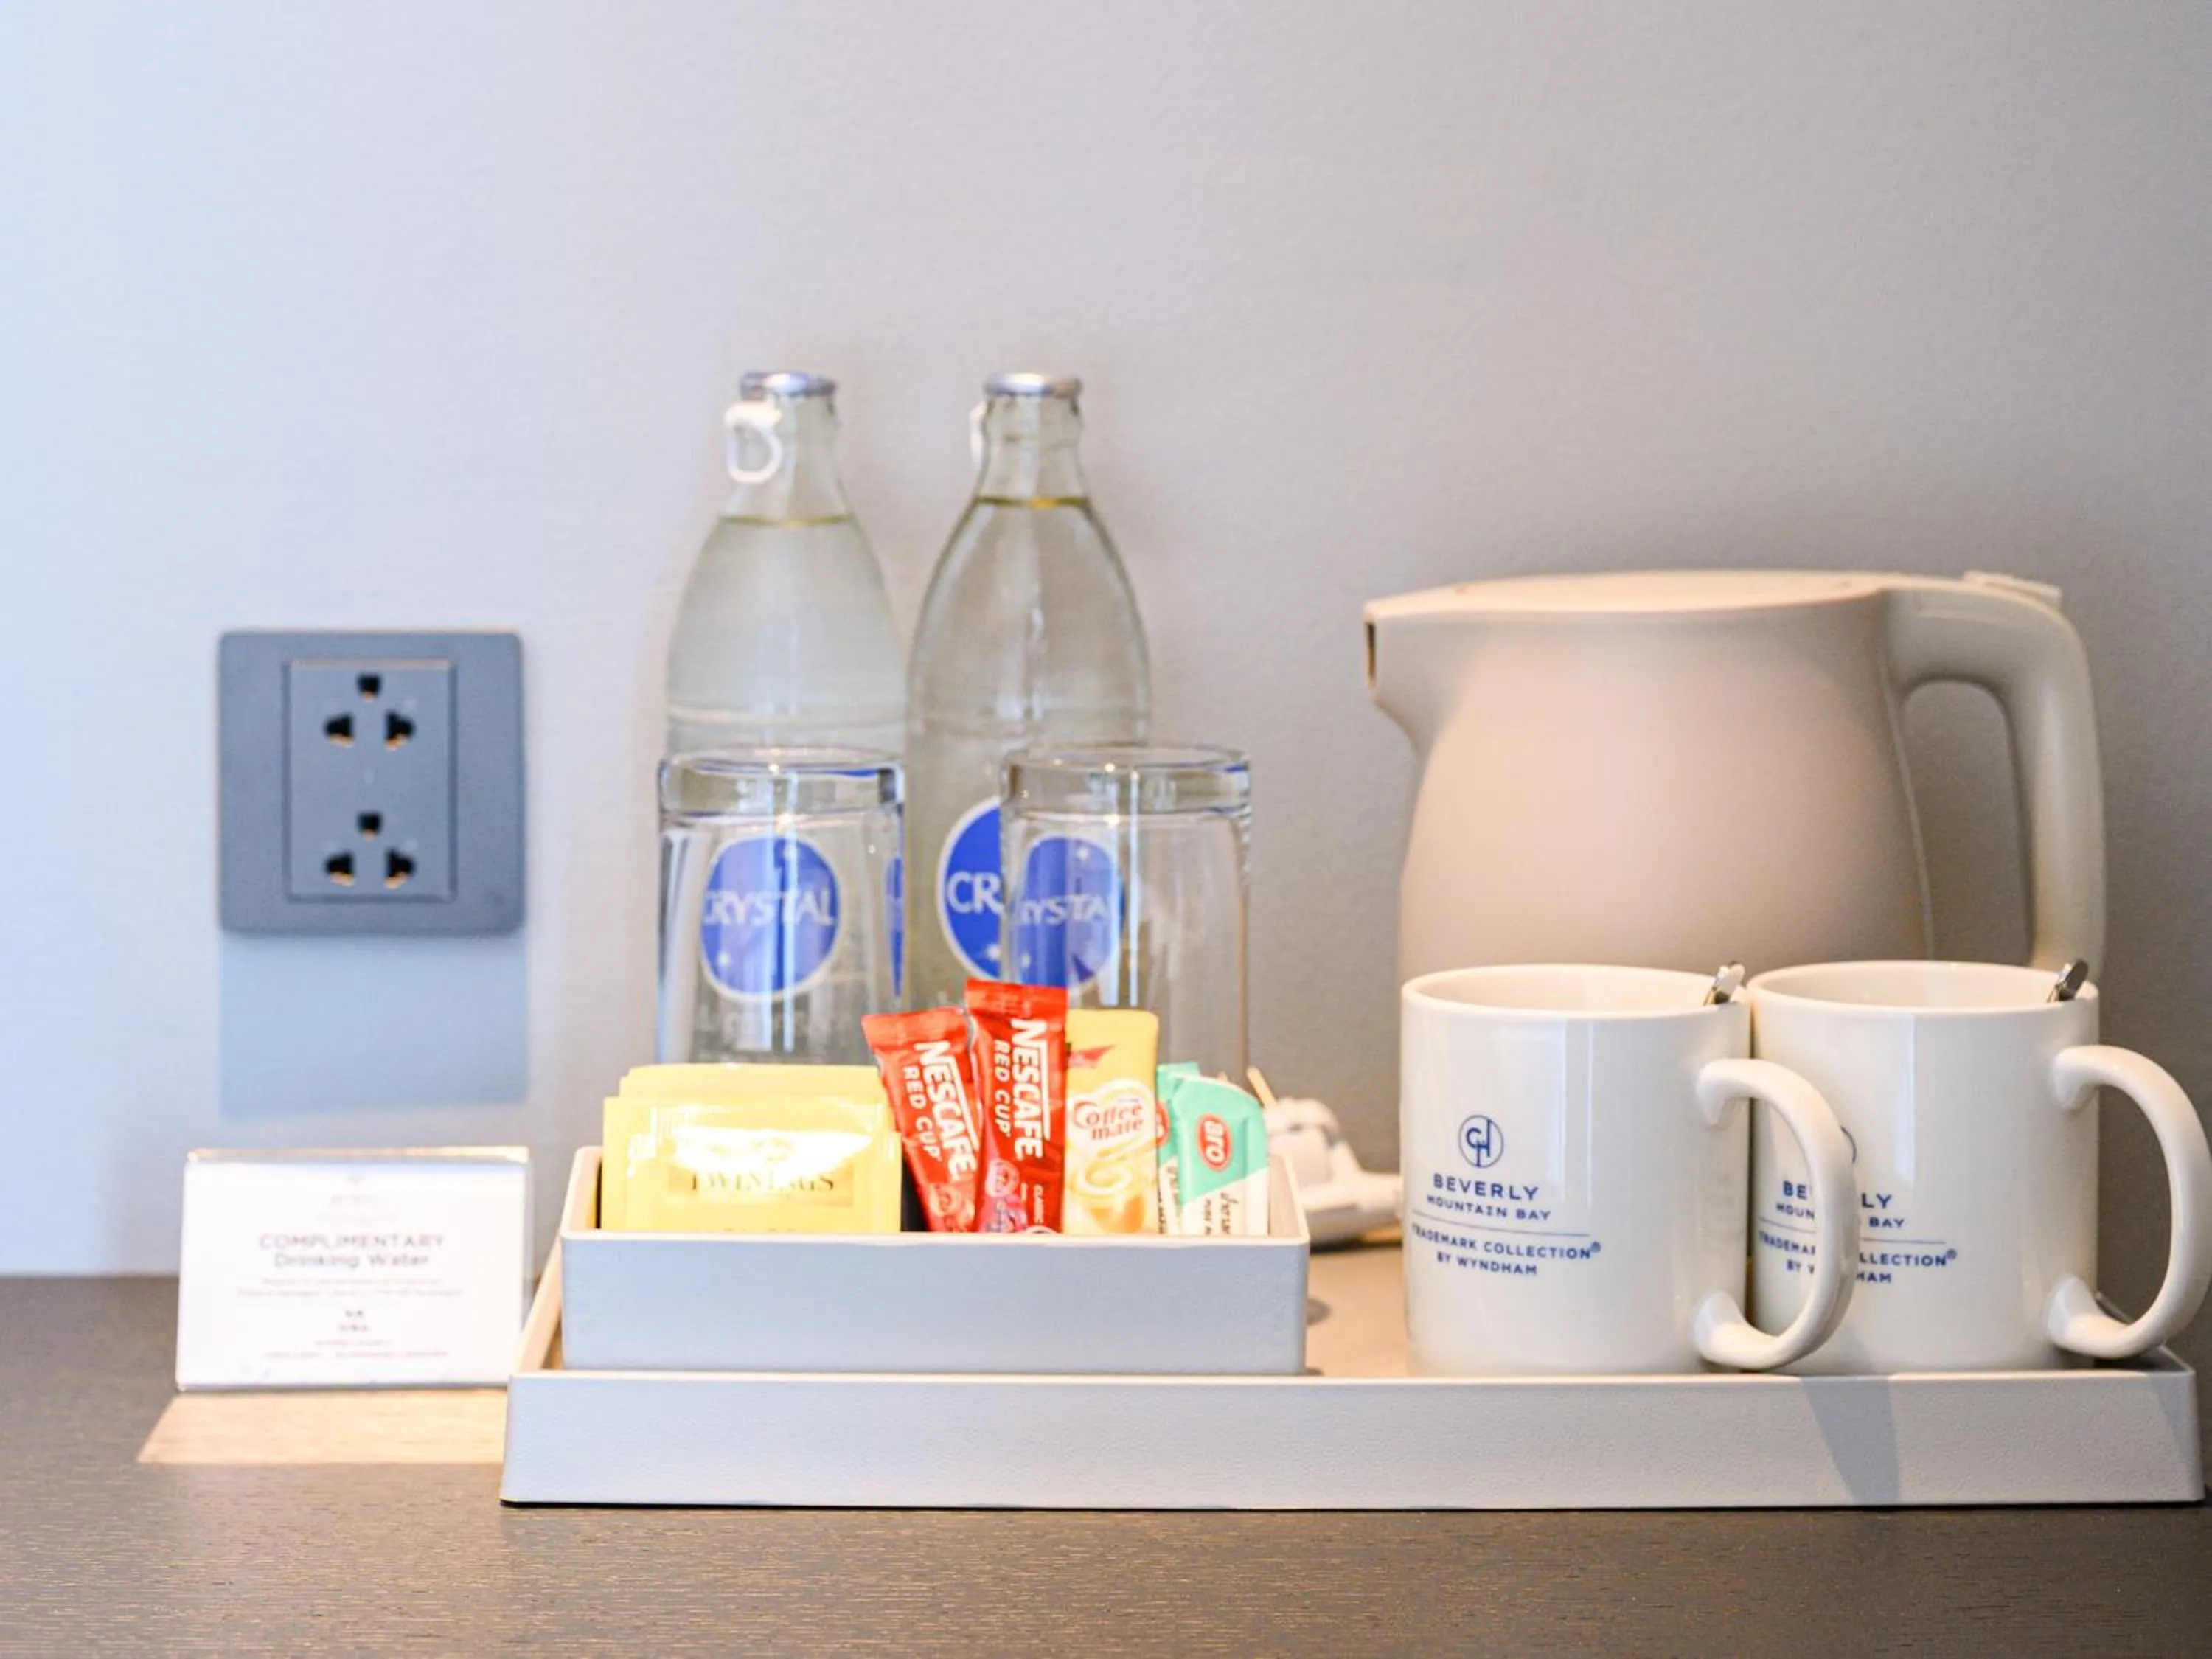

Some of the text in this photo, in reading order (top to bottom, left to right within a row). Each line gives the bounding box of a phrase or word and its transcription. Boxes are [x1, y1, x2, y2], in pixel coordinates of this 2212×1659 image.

[994, 1039, 1012, 1136] RED CUP
[902, 1065, 942, 1161] RED CUP
[1433, 1172, 1539, 1201] BEVERLY
[1427, 1194, 1551, 1221] MOUNTAIN BAY
[1411, 1222, 1477, 1250] TRADEMARK
[1868, 1217, 1905, 1229] BAY
[259, 1233, 444, 1250] COMPLIMENTARY
[274, 1251, 429, 1270] Drinking Water
[1436, 1250, 1537, 1276] BY WYNDHAM
[1787, 1259, 1801, 1272] BY
